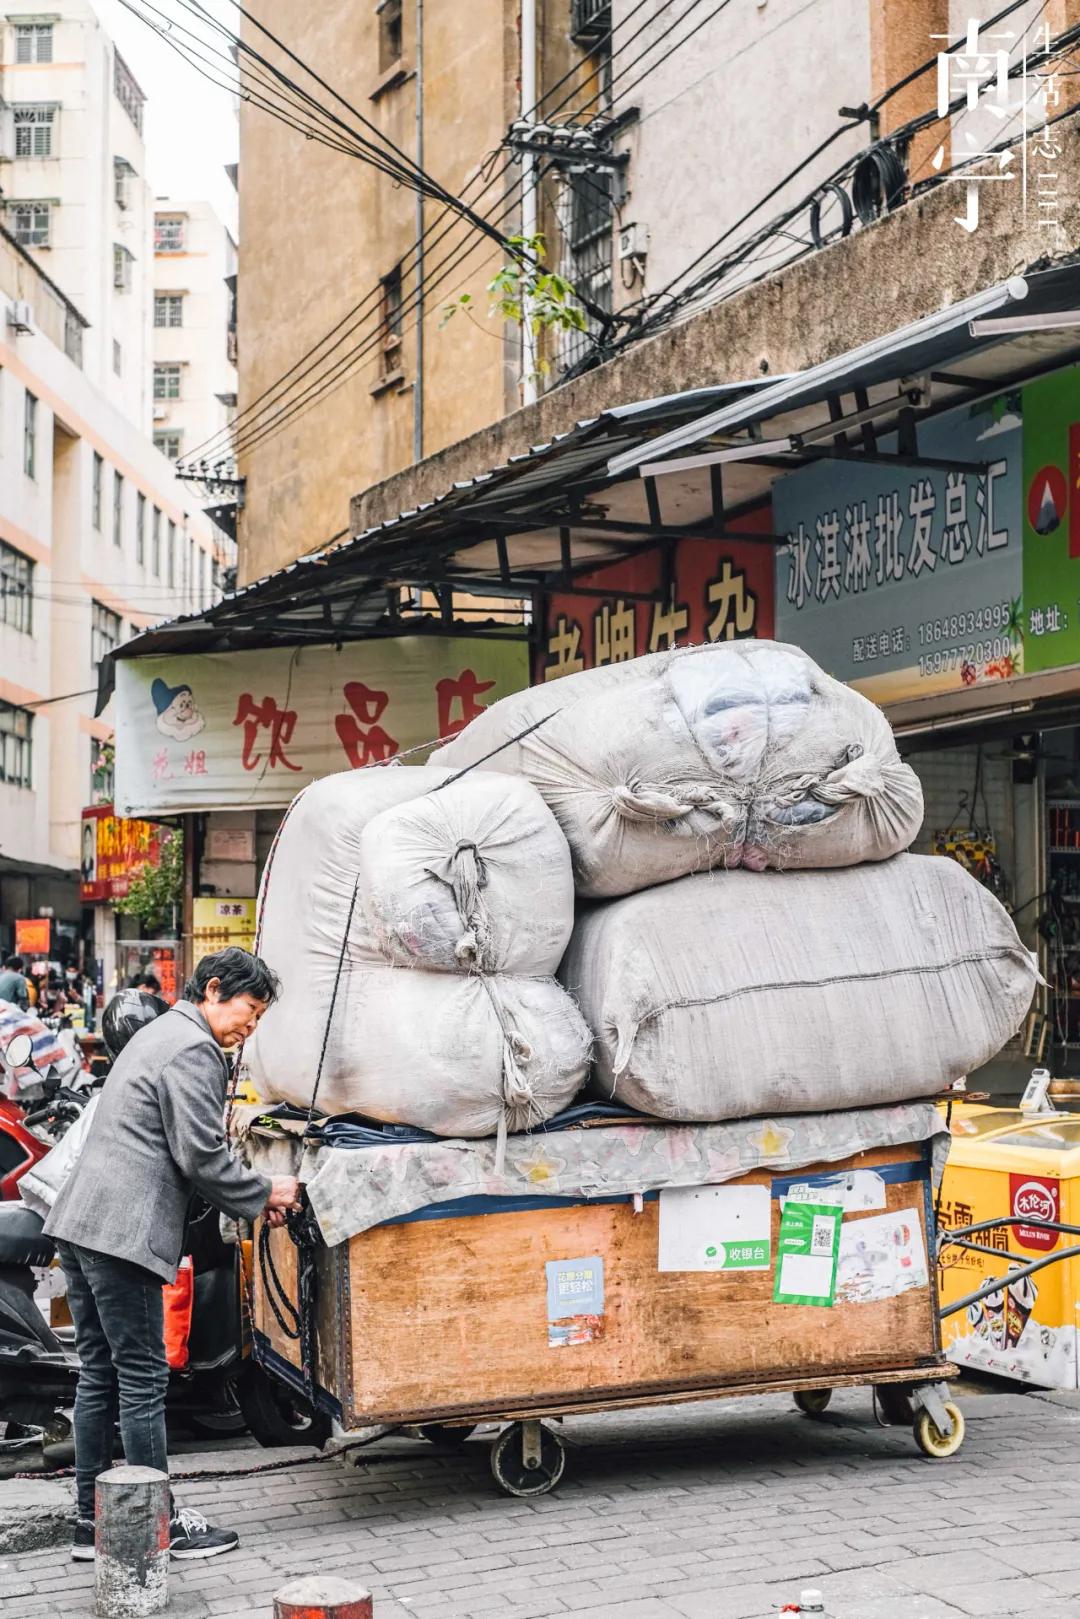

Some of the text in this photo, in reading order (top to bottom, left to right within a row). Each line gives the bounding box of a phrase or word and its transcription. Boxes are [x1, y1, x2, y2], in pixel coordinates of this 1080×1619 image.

[777, 459, 1008, 610] 冰淇淋批发总汇
[918, 603, 1010, 645] 18648934995
[918, 636, 1010, 677] 15977720300
[729, 1247, 765, 1261] 收银台
